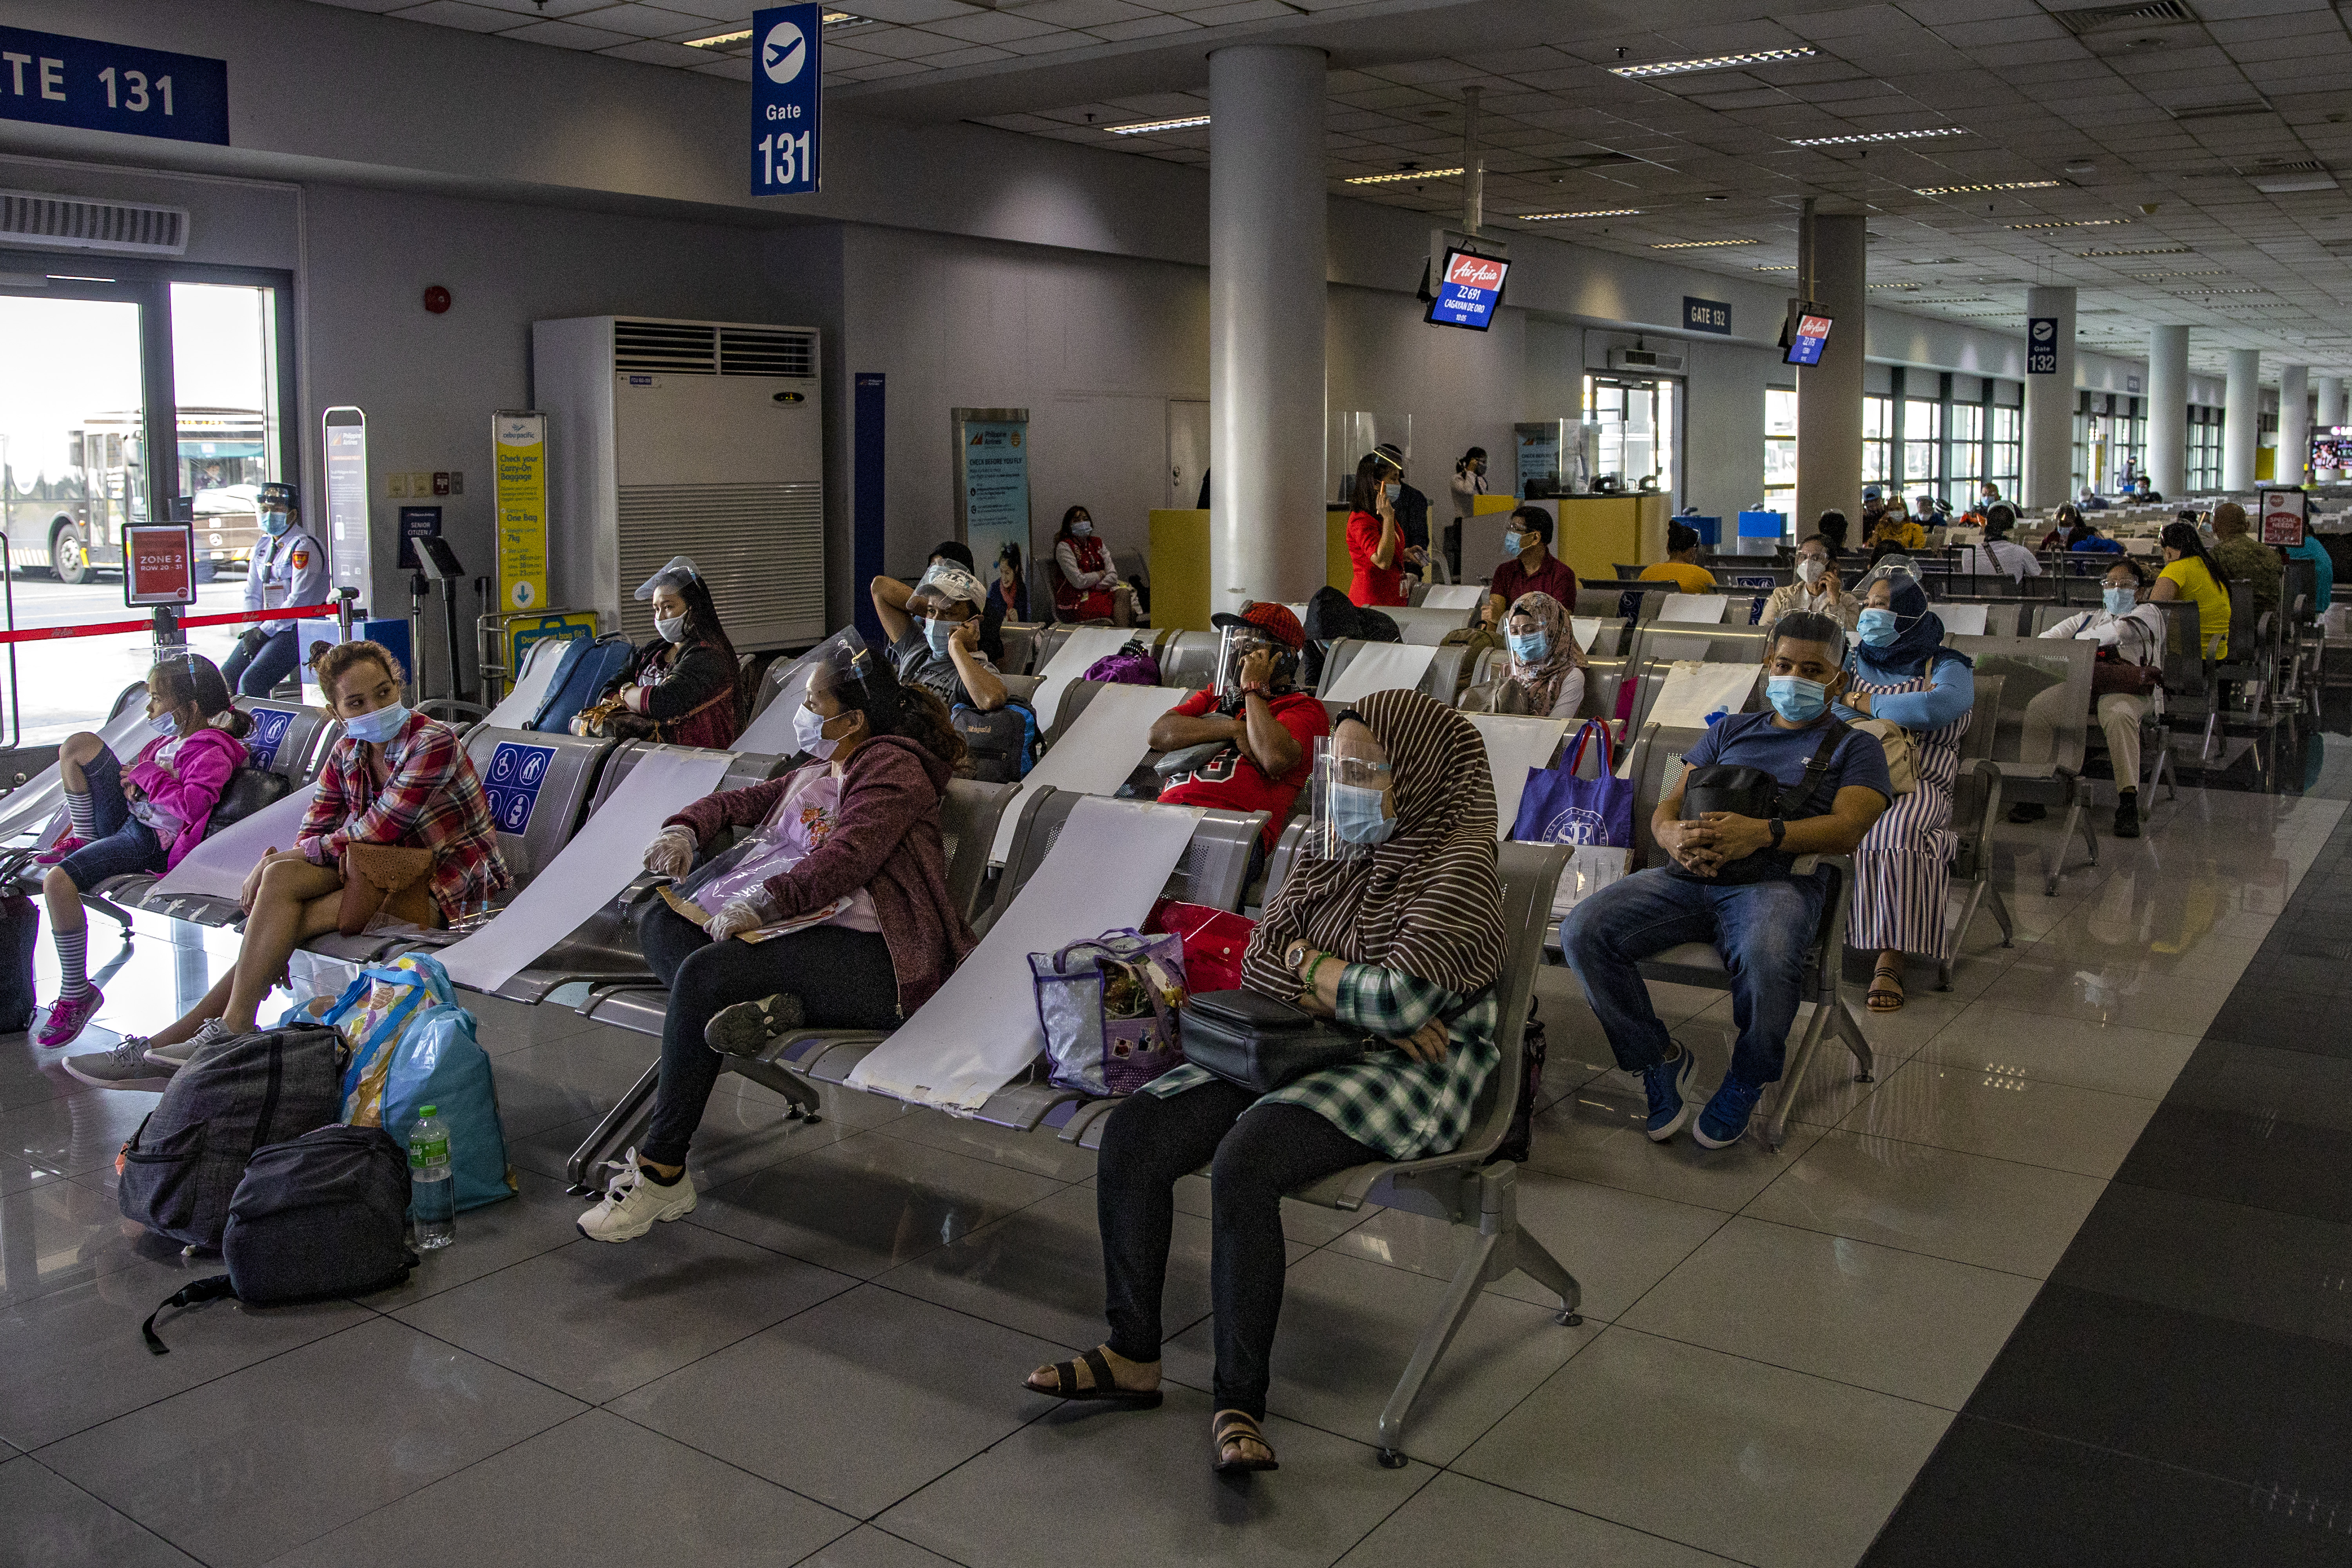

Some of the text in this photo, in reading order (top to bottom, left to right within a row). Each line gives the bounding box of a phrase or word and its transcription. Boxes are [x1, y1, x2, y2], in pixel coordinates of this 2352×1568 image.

[0, 52, 174, 116] TE 131
[766, 104, 801, 120] Gate
[759, 131, 809, 185] 131
[1457, 286, 1481, 300] Z2 691
[1444, 299, 1485, 313] CAGAYAN DE ORO
[1691, 306, 1725, 326] GATE 132
[2029, 355, 2054, 371] 132
[523, 456, 538, 464] your
[501, 464, 532, 473] Carry-On
[501, 473, 532, 482] Baggage
[523, 514, 537, 523] Bag
[507, 534, 520, 543] 7kg
[140, 555, 171, 564] ZONE
[559, 632, 572, 641] bag
[573, 630, 585, 638] fit?
